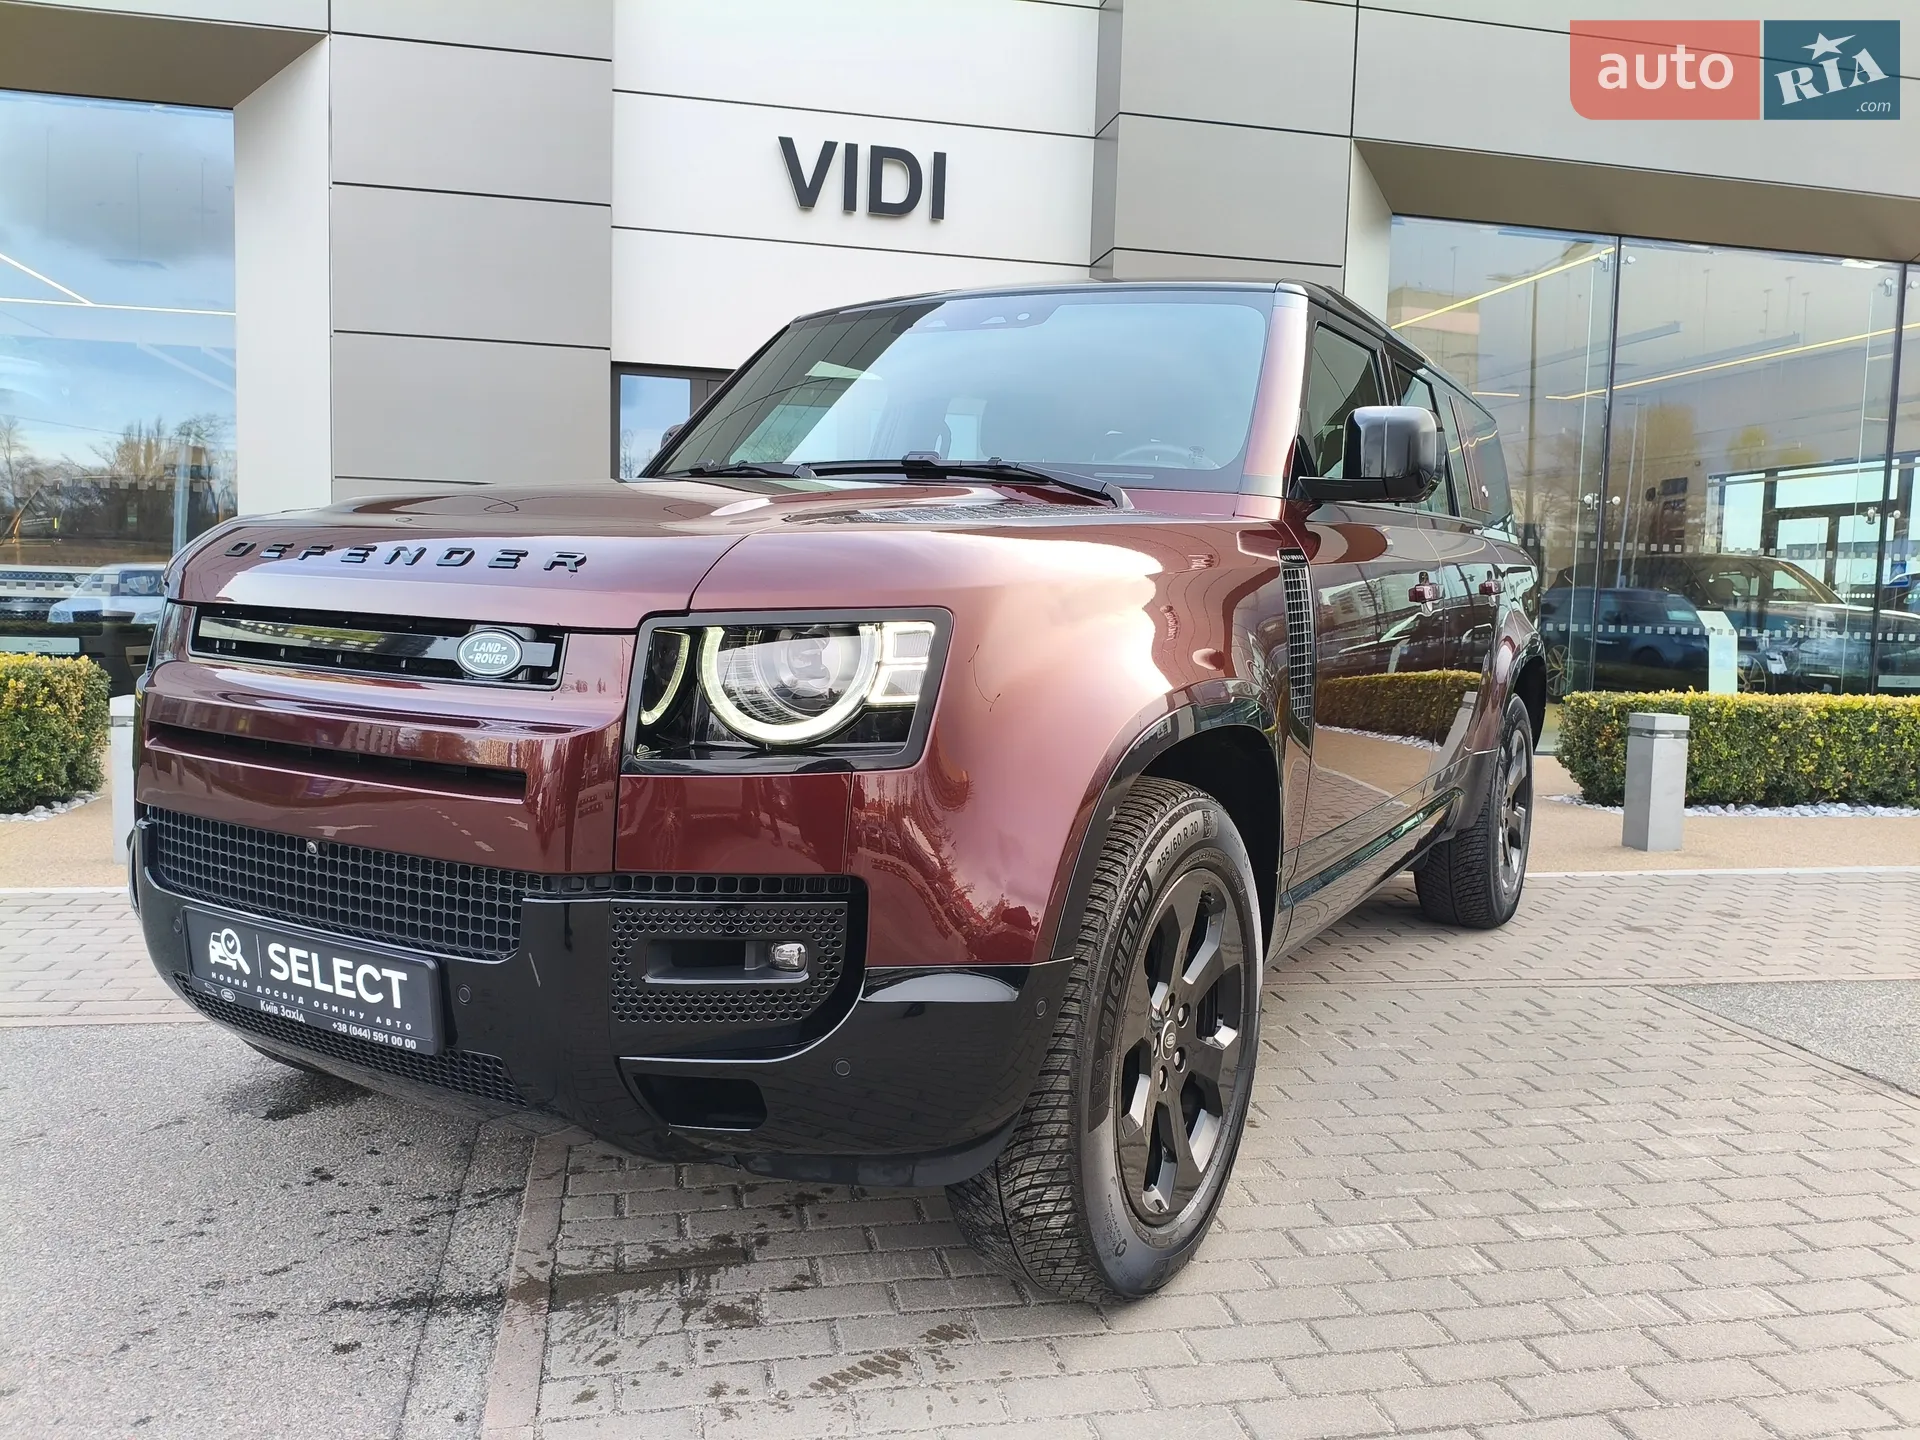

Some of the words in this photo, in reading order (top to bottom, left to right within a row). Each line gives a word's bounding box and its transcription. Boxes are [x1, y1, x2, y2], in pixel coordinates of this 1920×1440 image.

[777, 135, 948, 221] VIDI
[224, 541, 588, 573] DEFENDER
[267, 942, 408, 1009] SELECT
[1101, 879, 1150, 1045] MICHELIN
[211, 972, 248, 989] НОВИЙ
[256, 985, 305, 1005] ДОСВІД
[313, 1000, 365, 1019] ОБМІНУ
[376, 1016, 412, 1031] АВТО
[260, 1000, 279, 1015] Київ
[332, 1022, 348, 1033] +38
[349, 1024, 371, 1040] (044)
[373, 1031, 389, 1044] 591
[391, 1035, 403, 1047] 00
[405, 1039, 417, 1050] 00
